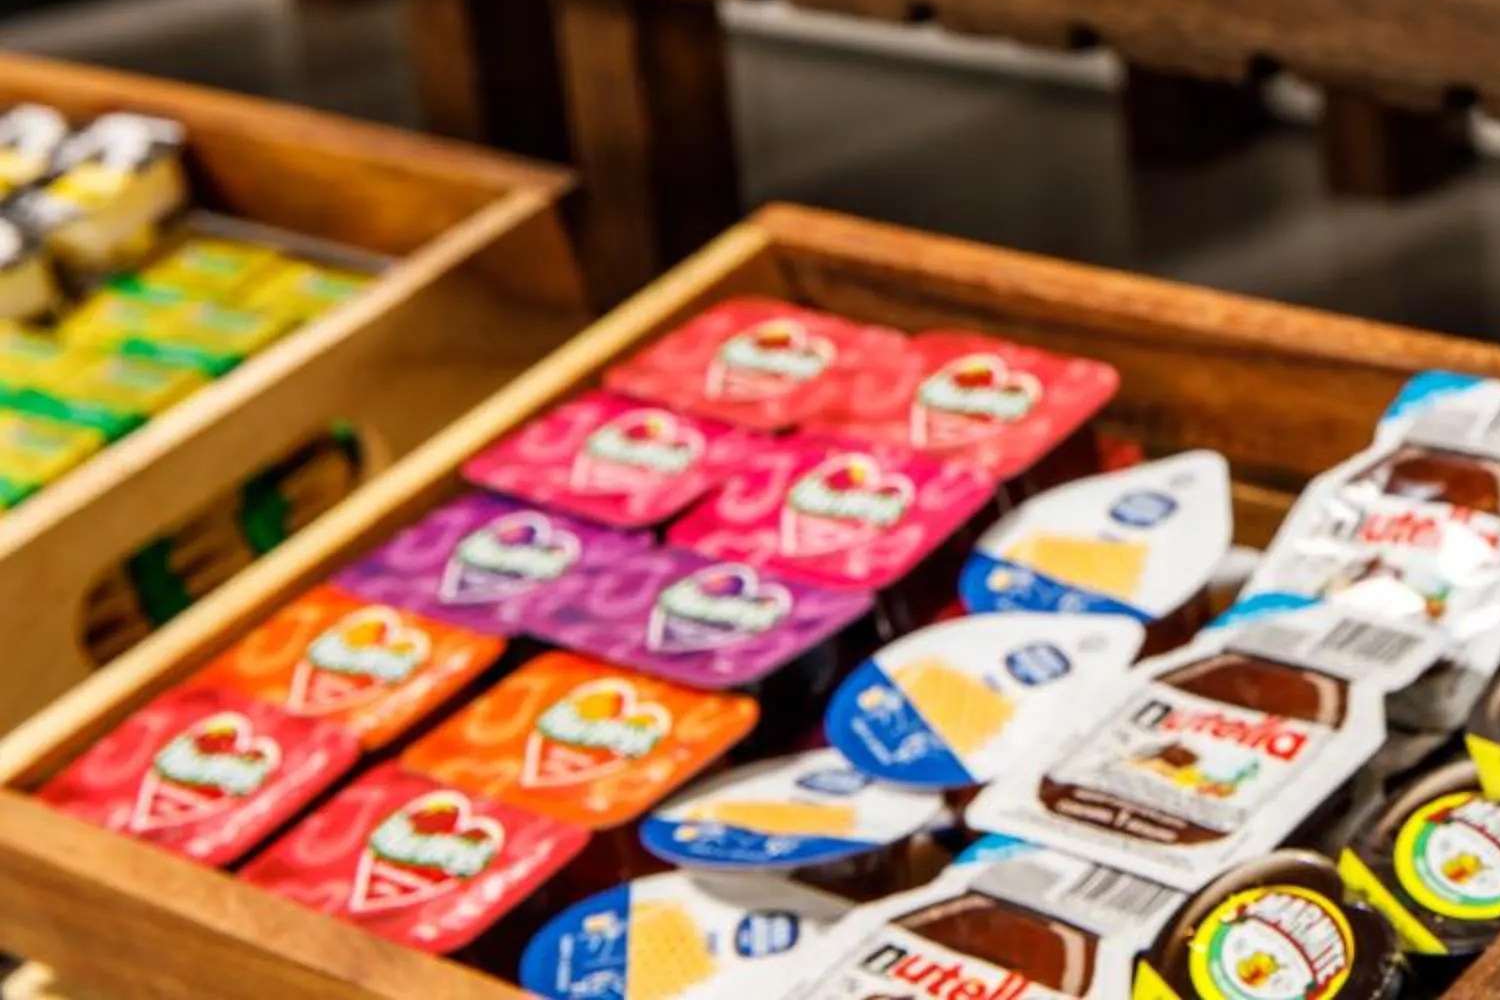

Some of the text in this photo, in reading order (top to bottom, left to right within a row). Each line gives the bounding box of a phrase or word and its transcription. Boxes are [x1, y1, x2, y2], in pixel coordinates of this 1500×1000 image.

[1133, 700, 1307, 760] nutella
[1246, 893, 1348, 987] MARMITE
[861, 944, 1031, 1000] nutell
